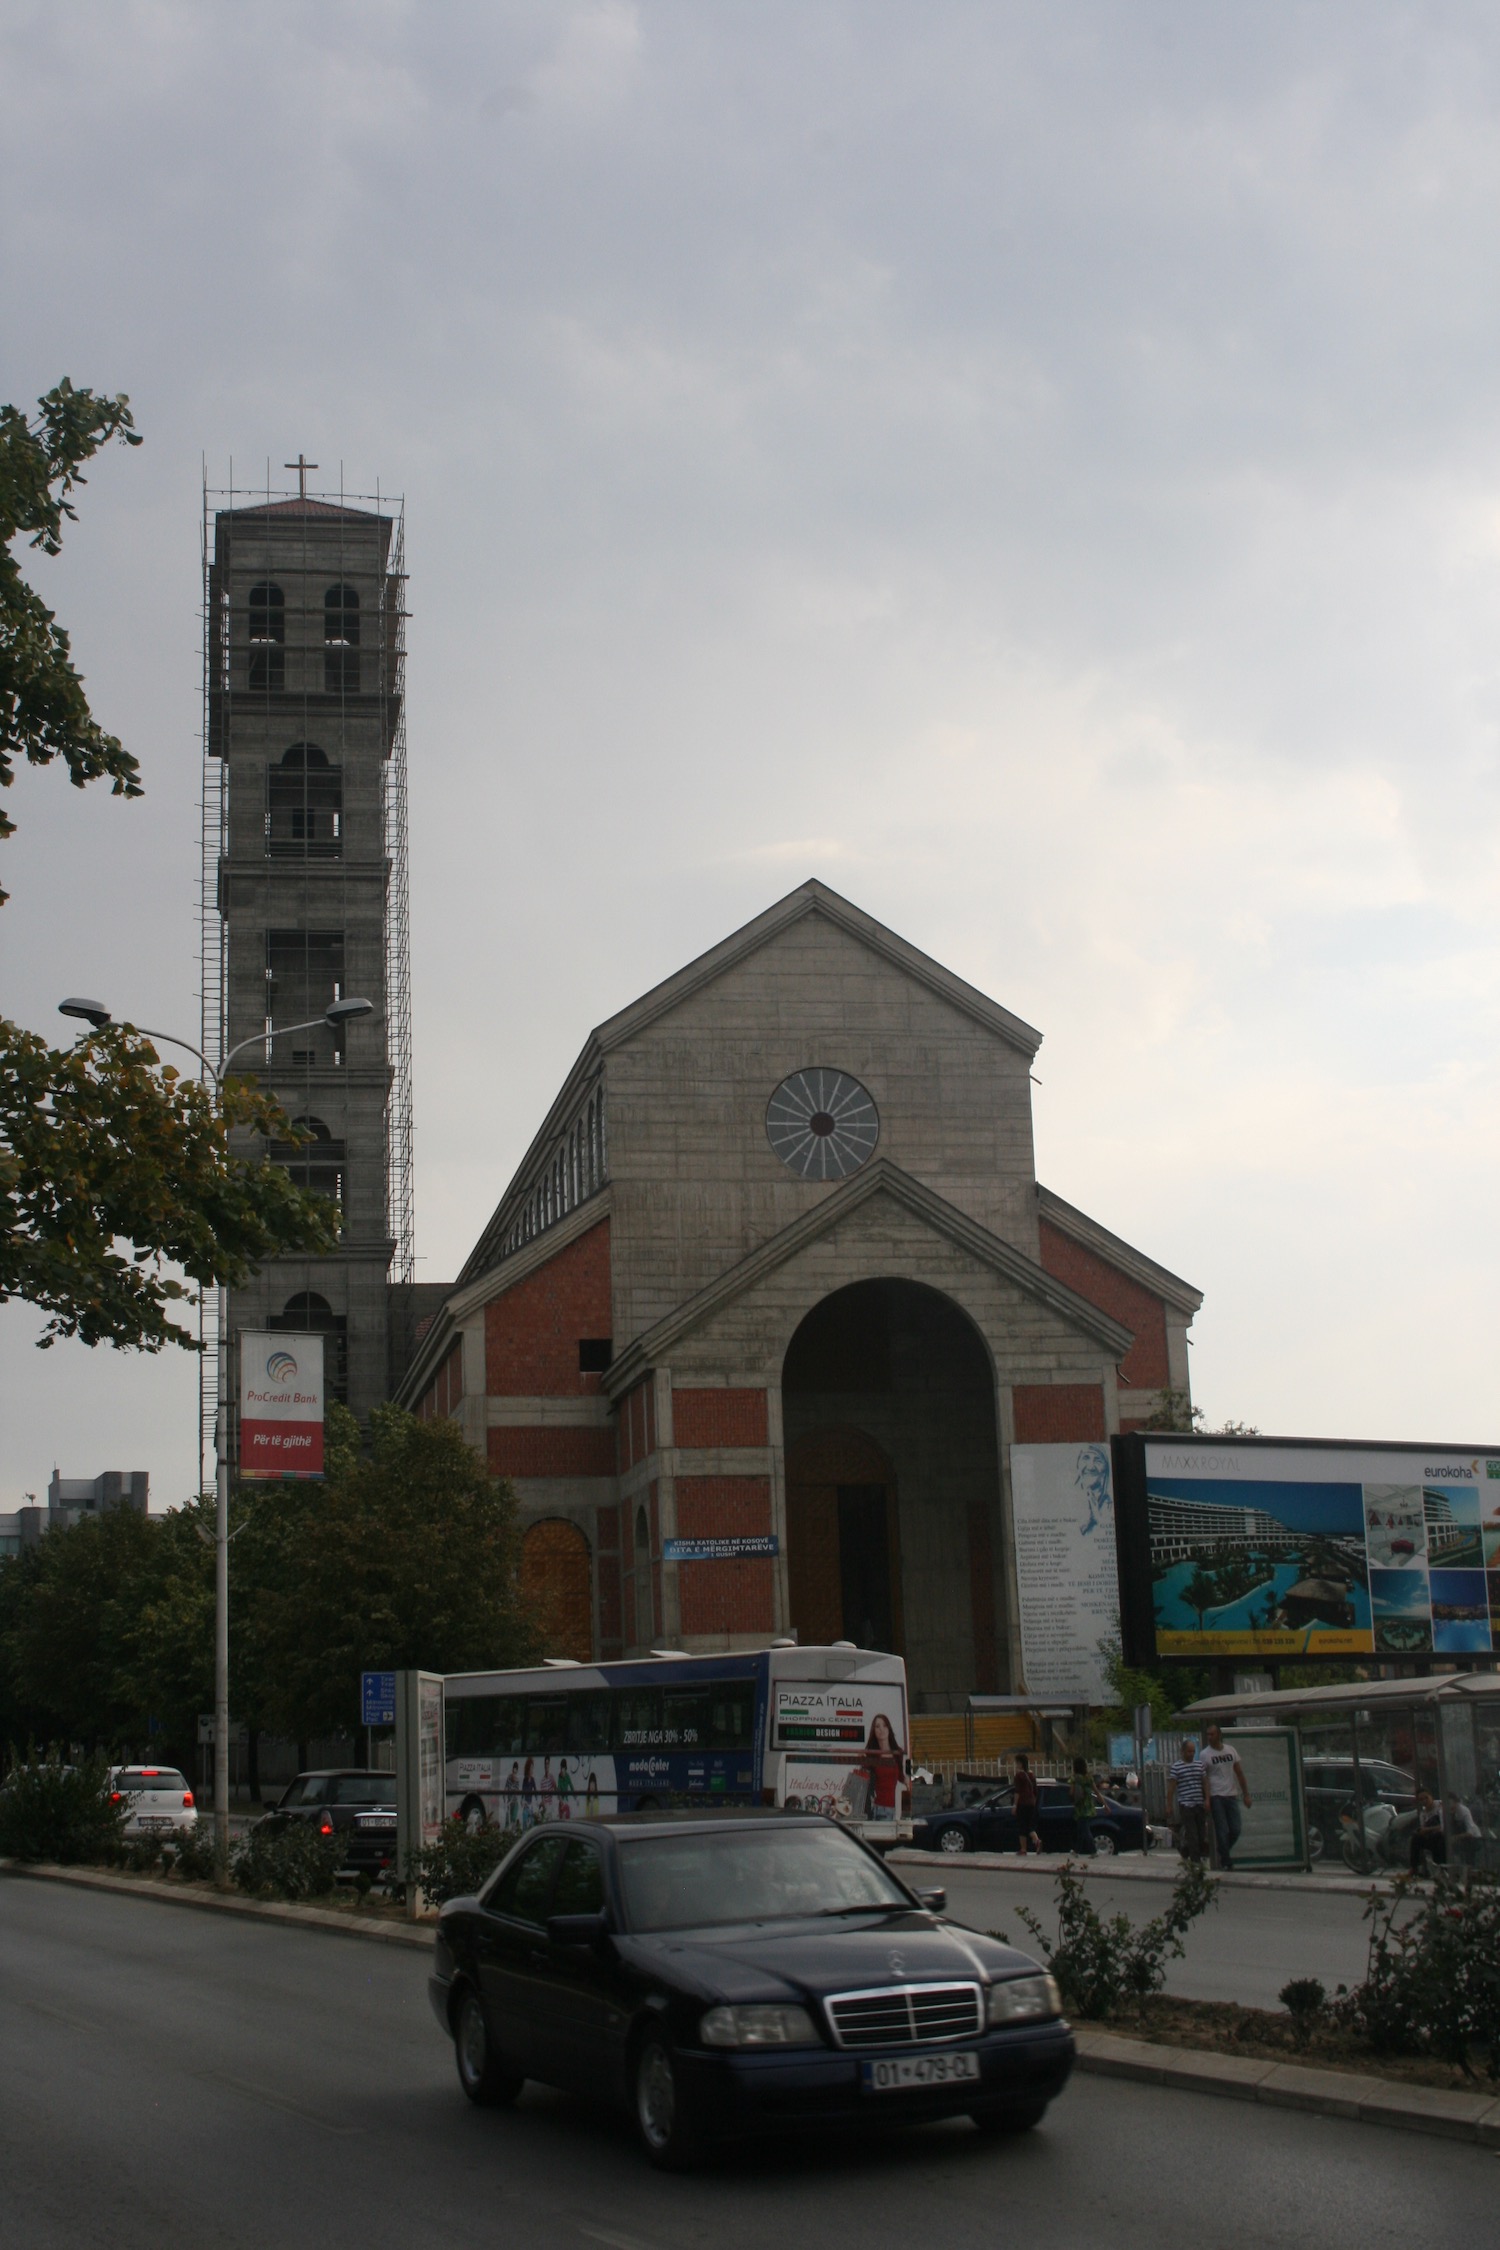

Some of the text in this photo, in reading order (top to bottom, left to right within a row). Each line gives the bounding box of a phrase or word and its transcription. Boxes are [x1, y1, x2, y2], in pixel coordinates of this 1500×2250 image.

[247, 1390, 318, 1404] ProCredit Bank
[253, 1434, 312, 1449] Për të gjithë
[1424, 1466, 1472, 1478] eurokoha
[703, 1543, 774, 1553] MËRGIMTARËVE
[623, 1730, 647, 1744] ZBRITJE
[648, 1730, 663, 1743] NGA
[664, 1730, 678, 1743] 30%
[683, 1729, 698, 1742] 50%
[816, 1728, 840, 1737] DESIGN
[789, 1776, 819, 1790] Italian
[877, 2062, 900, 2086] 01
